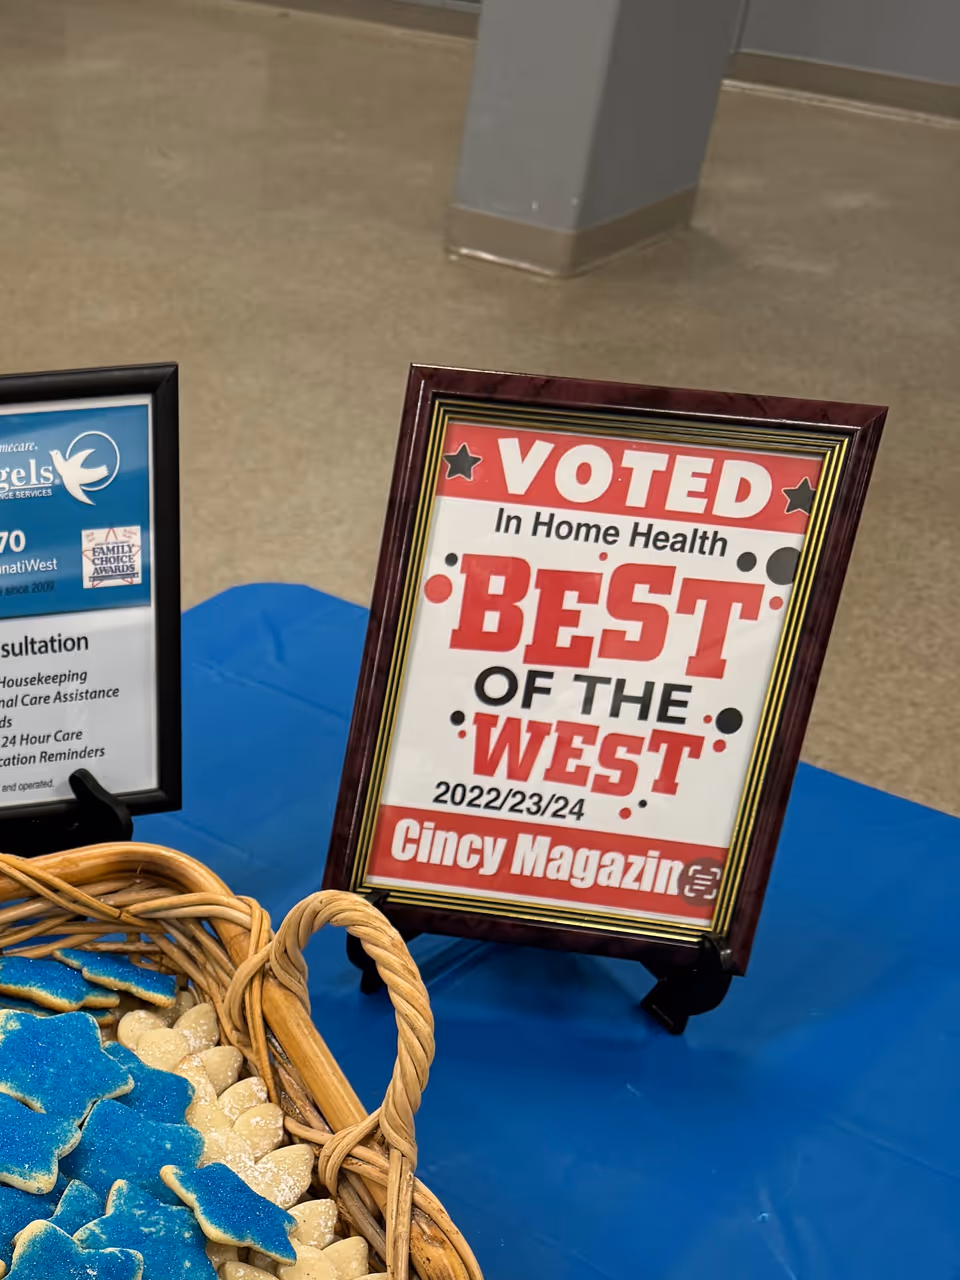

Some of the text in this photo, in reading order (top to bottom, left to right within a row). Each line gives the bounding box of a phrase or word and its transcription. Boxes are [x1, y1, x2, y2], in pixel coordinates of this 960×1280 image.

[497, 437, 773, 519] VOTED
[14, 488, 53, 498] SERVICES
[494, 507, 728, 557] In Home Health
[92, 543, 135, 557] FAMILY
[92, 554, 135, 566] CHOICE
[92, 564, 135, 575] AWARDS
[4, 583, 29, 595] since
[449, 552, 765, 679] BEST
[20, 692, 52, 708] Care
[52, 686, 120, 705] Assistance
[474, 666, 693, 725] OF THE
[0, 735, 17, 750] 24
[19, 730, 52, 748] Hour
[53, 728, 84, 745] Care
[39, 744, 106, 764] Reminders
[471, 713, 705, 798] WEST
[1, 781, 17, 795] and
[18, 777, 55, 794] operated.
[432, 780, 585, 822] 2022/23/24
[390, 818, 695, 896] Cincy Magazin
